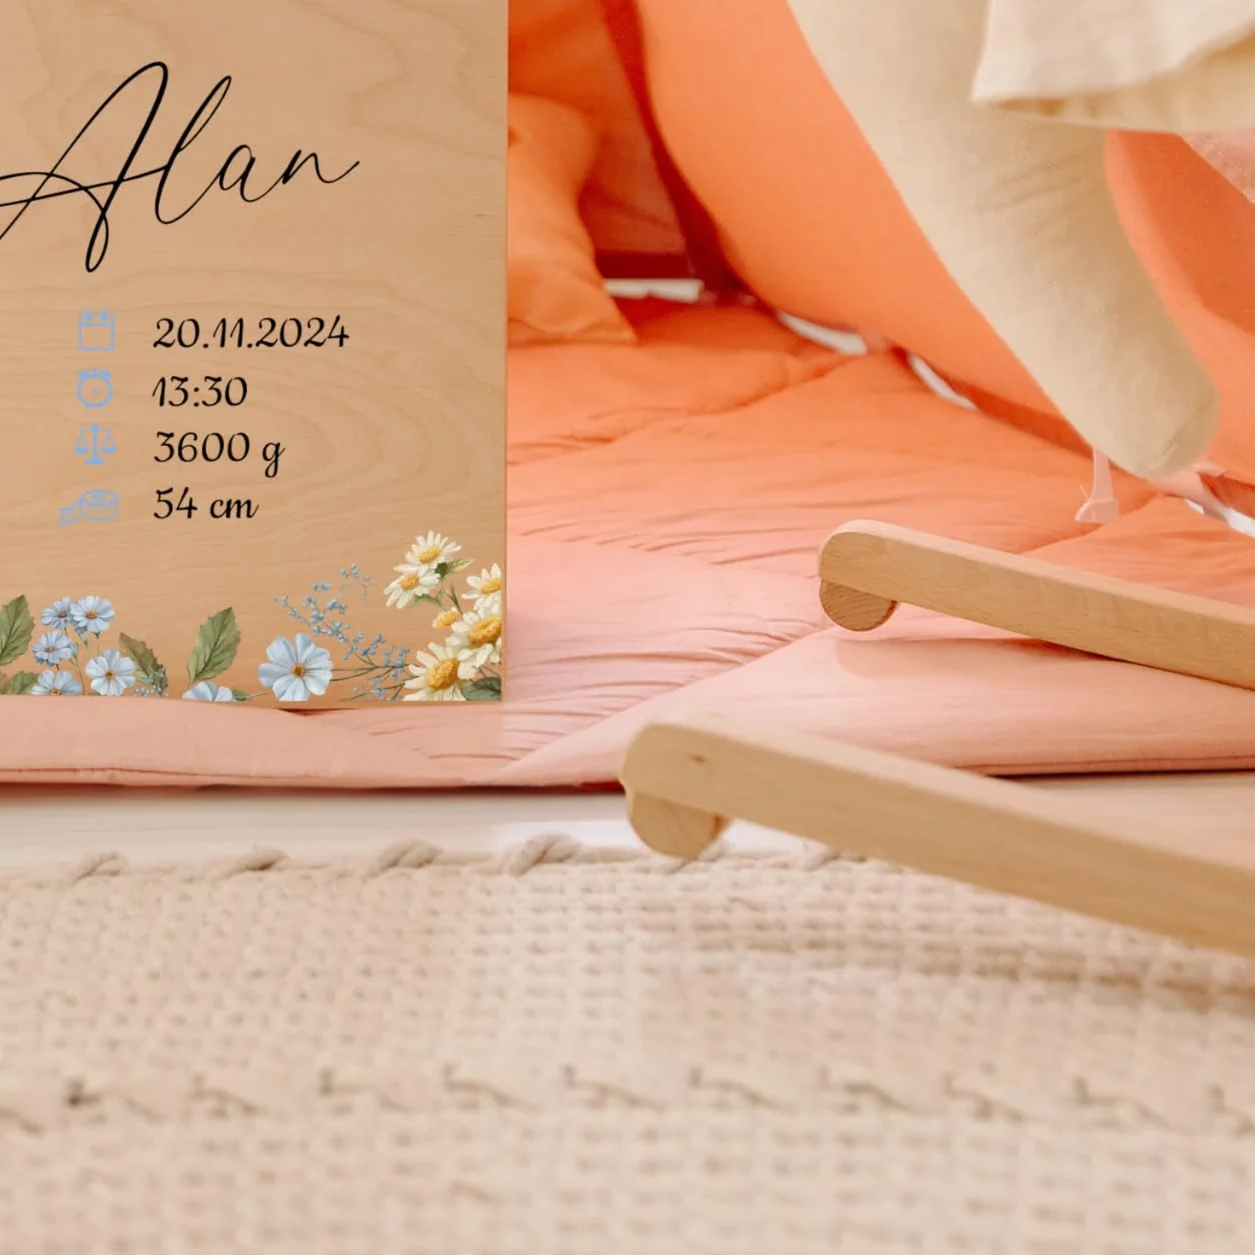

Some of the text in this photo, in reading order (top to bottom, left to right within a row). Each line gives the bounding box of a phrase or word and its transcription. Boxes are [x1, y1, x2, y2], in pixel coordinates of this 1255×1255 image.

[152, 314, 350, 349] 20.11.2024
[151, 375, 248, 407] 13:30
[153, 431, 286, 479] 3600 g
[153, 486, 259, 519] 54 cm
